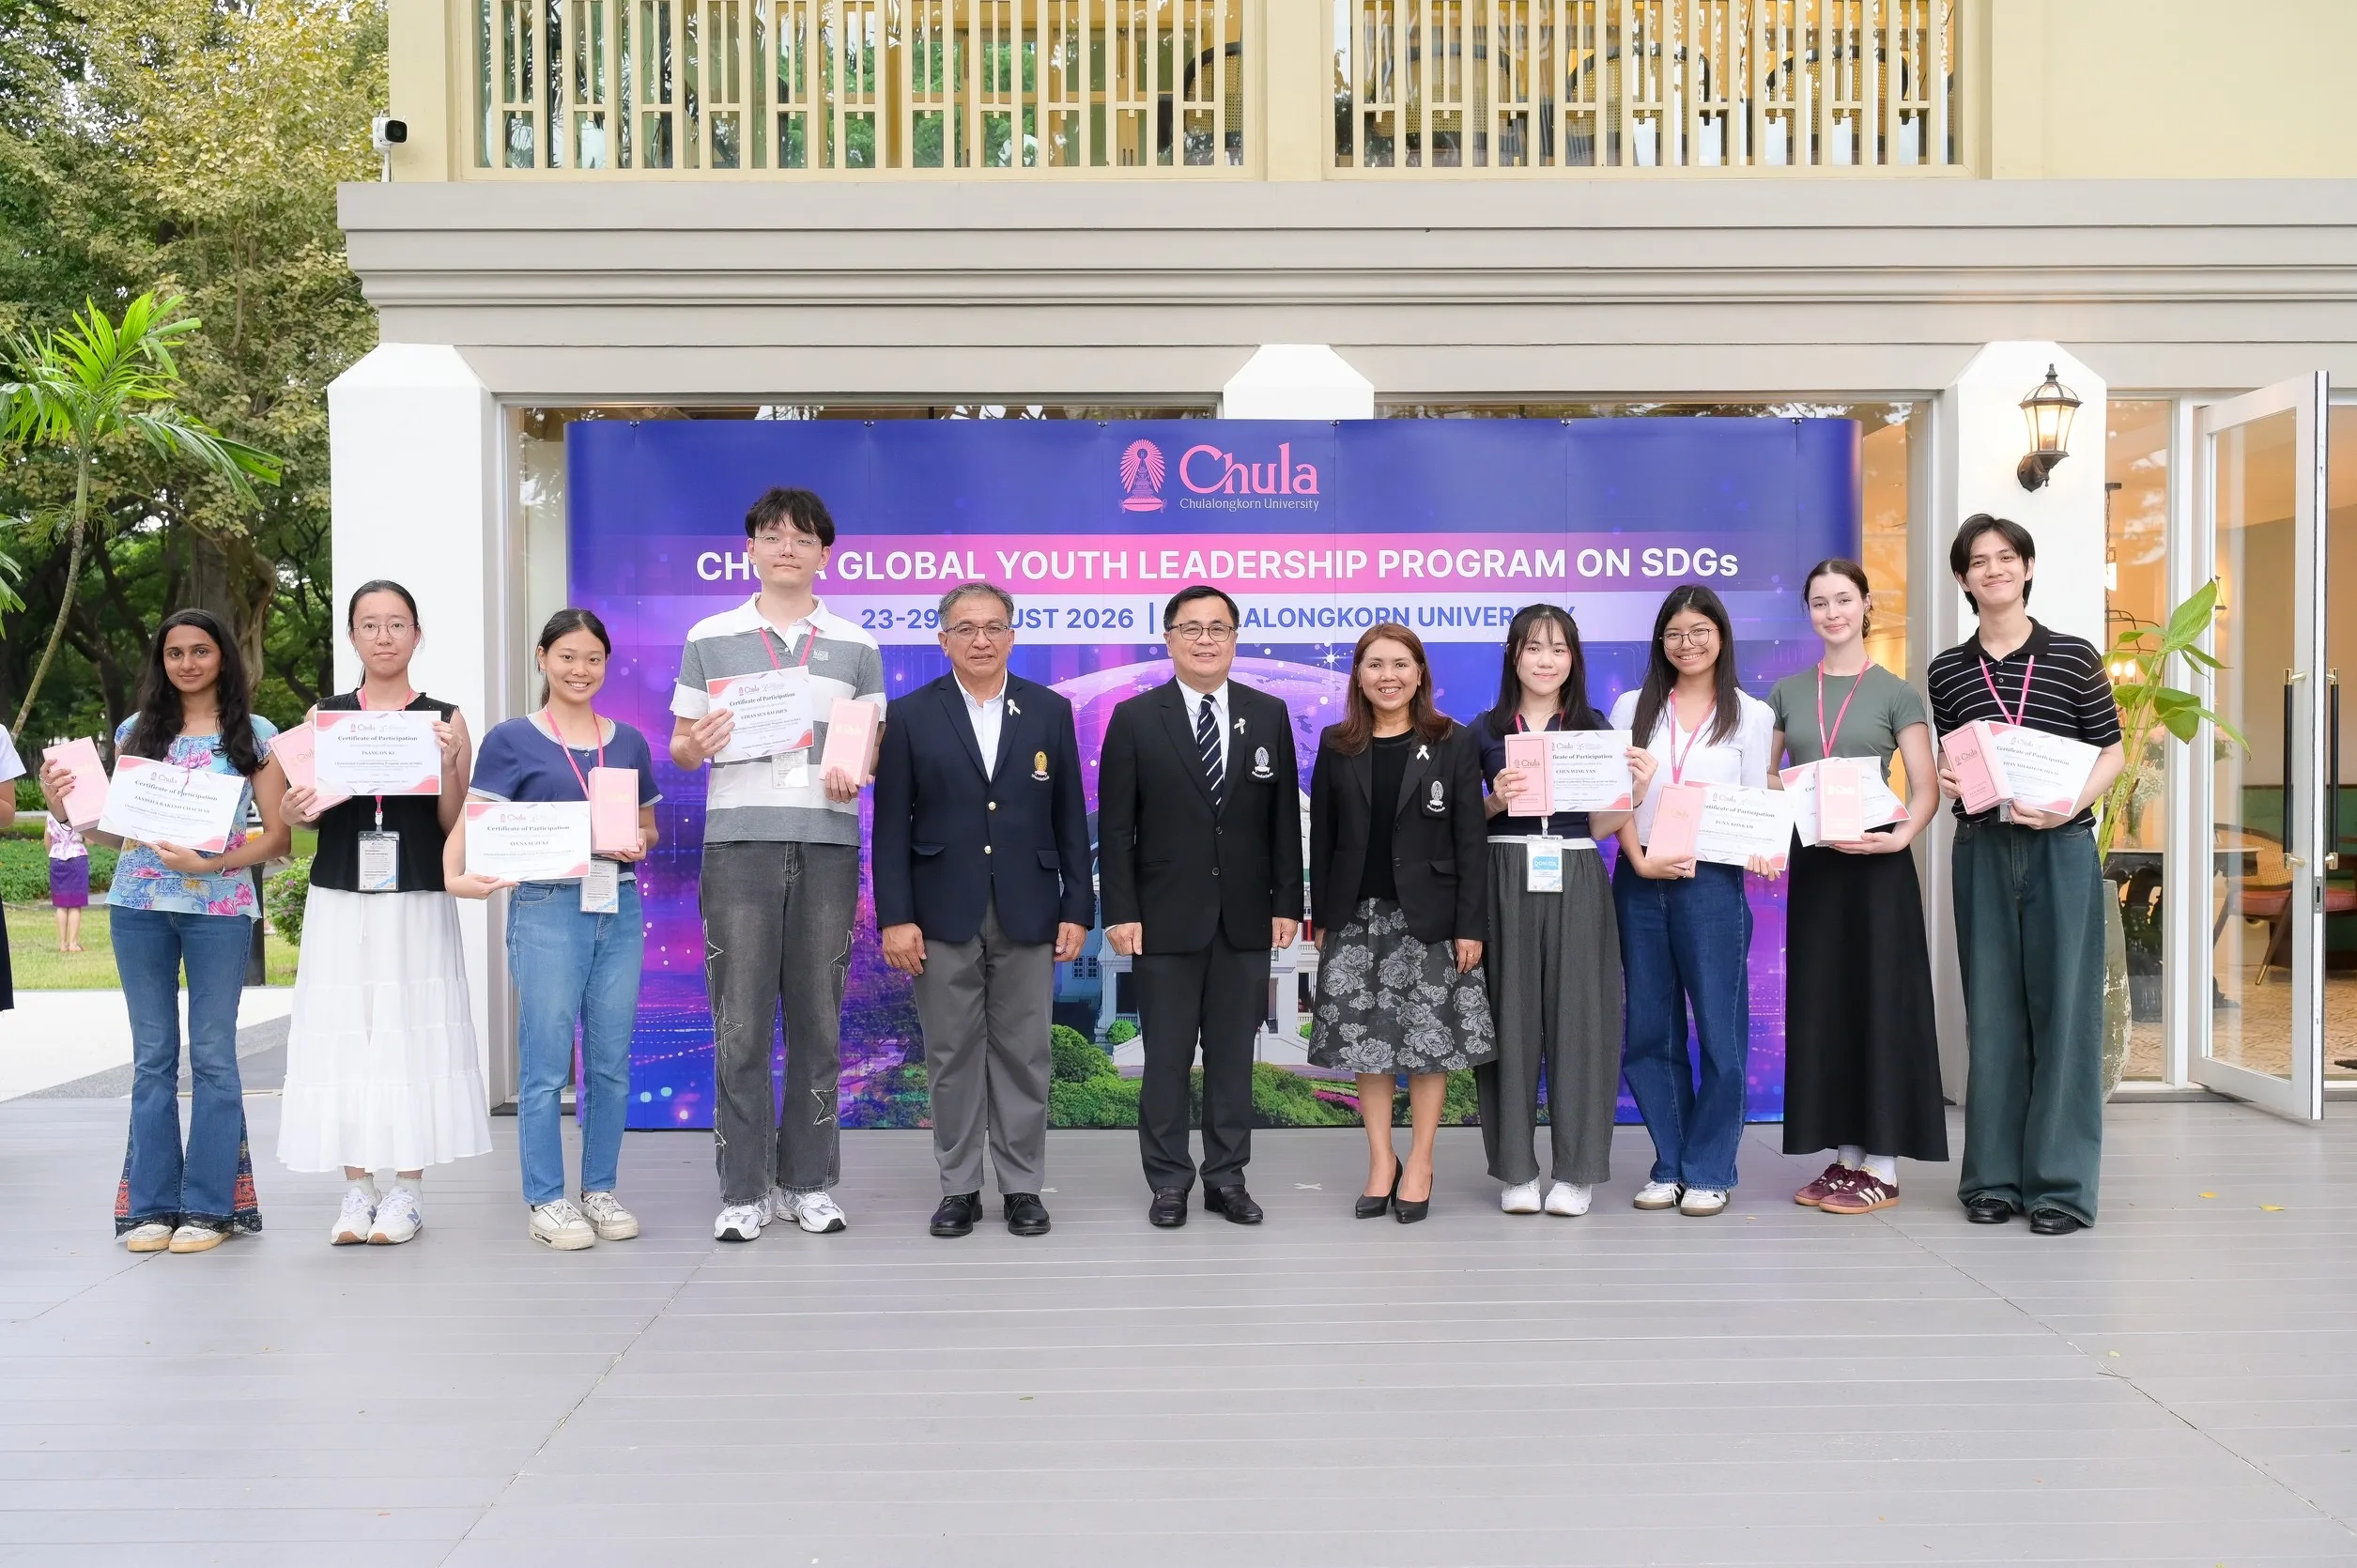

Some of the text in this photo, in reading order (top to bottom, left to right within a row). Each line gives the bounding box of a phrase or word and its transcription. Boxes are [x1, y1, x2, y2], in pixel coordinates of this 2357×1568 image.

[1179, 442, 1319, 494] Chula
[1179, 498, 1319, 513] Chulalongkorn University
[838, 551, 986, 580] GLOBAL
[995, 550, 1128, 580] YOUTH
[1139, 549, 1368, 579] LEADERSHIP
[1379, 549, 1565, 578] PROGRAM
[1577, 548, 1630, 577] ON
[1641, 547, 1738, 577] SDGs
[861, 608, 939, 629] 23-29
[1011, 608, 1059, 629] UST
[1067, 608, 1133, 629] 2026
[1239, 607, 1410, 628] ALONGKORN
[1418, 606, 1575, 627] UNIVER
[763, 692, 795, 701] Participation
[1996, 746, 2025, 754] Certificate
[2032, 753, 2070, 765] Participation
[134, 780, 168, 792] Certificate
[177, 791, 218, 801] Participation
[1736, 808, 1775, 818] Participation
